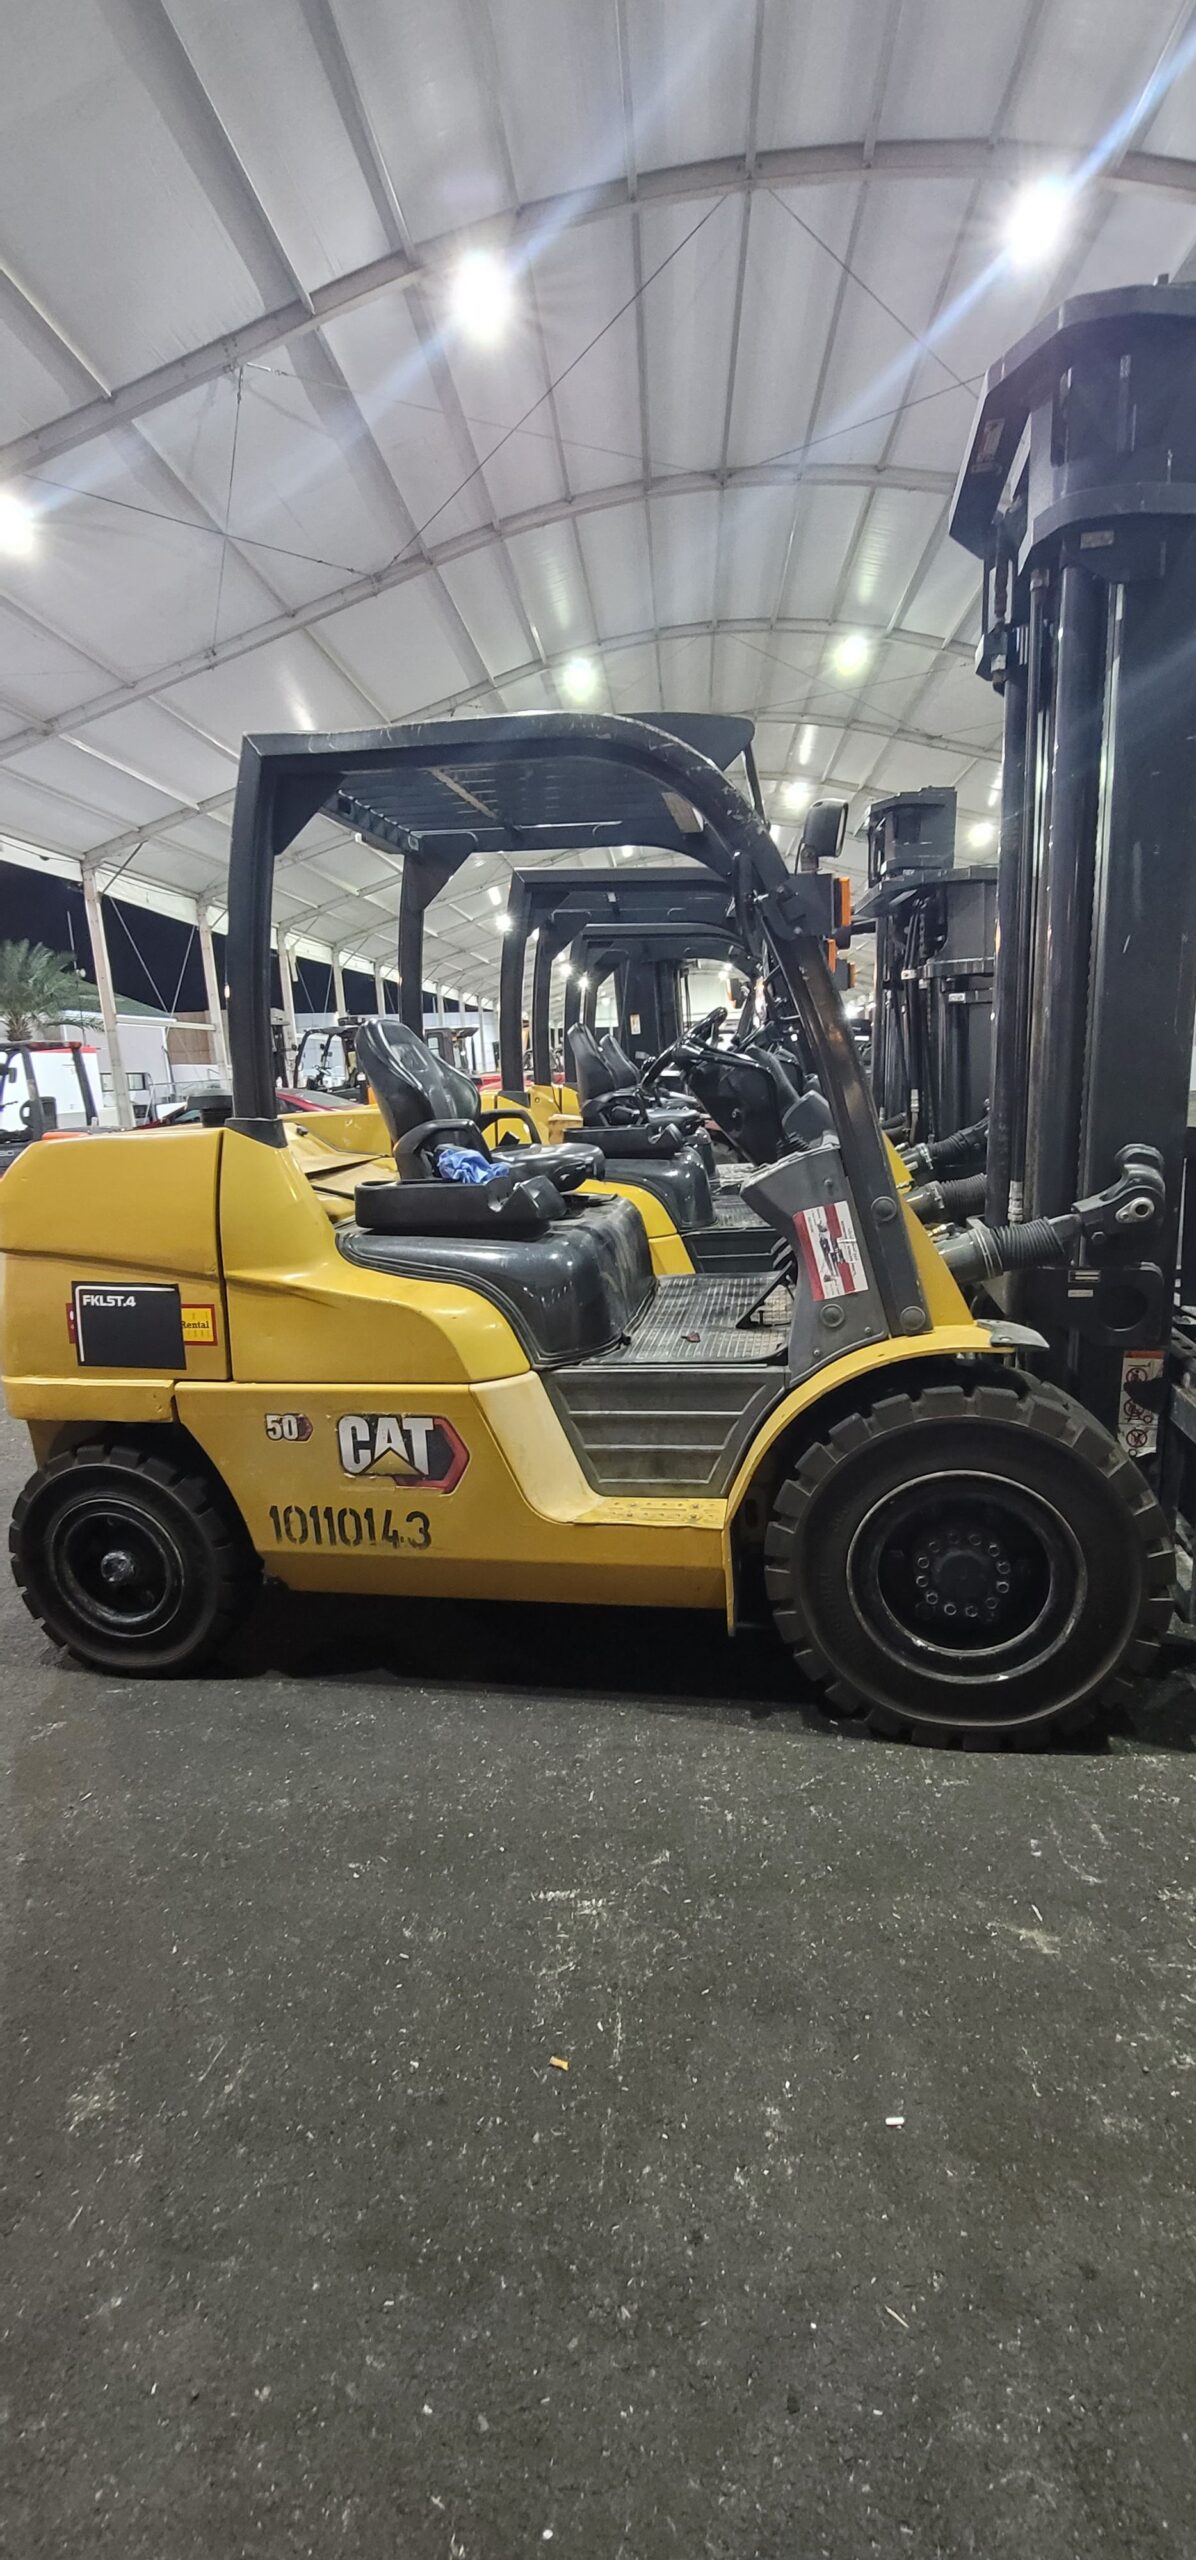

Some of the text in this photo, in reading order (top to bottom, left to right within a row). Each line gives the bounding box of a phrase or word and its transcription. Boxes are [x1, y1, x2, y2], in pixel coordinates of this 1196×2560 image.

[266, 1414, 298, 1441] 50
[338, 1415, 434, 1475] CAT
[269, 1505, 432, 1550] 10110143
